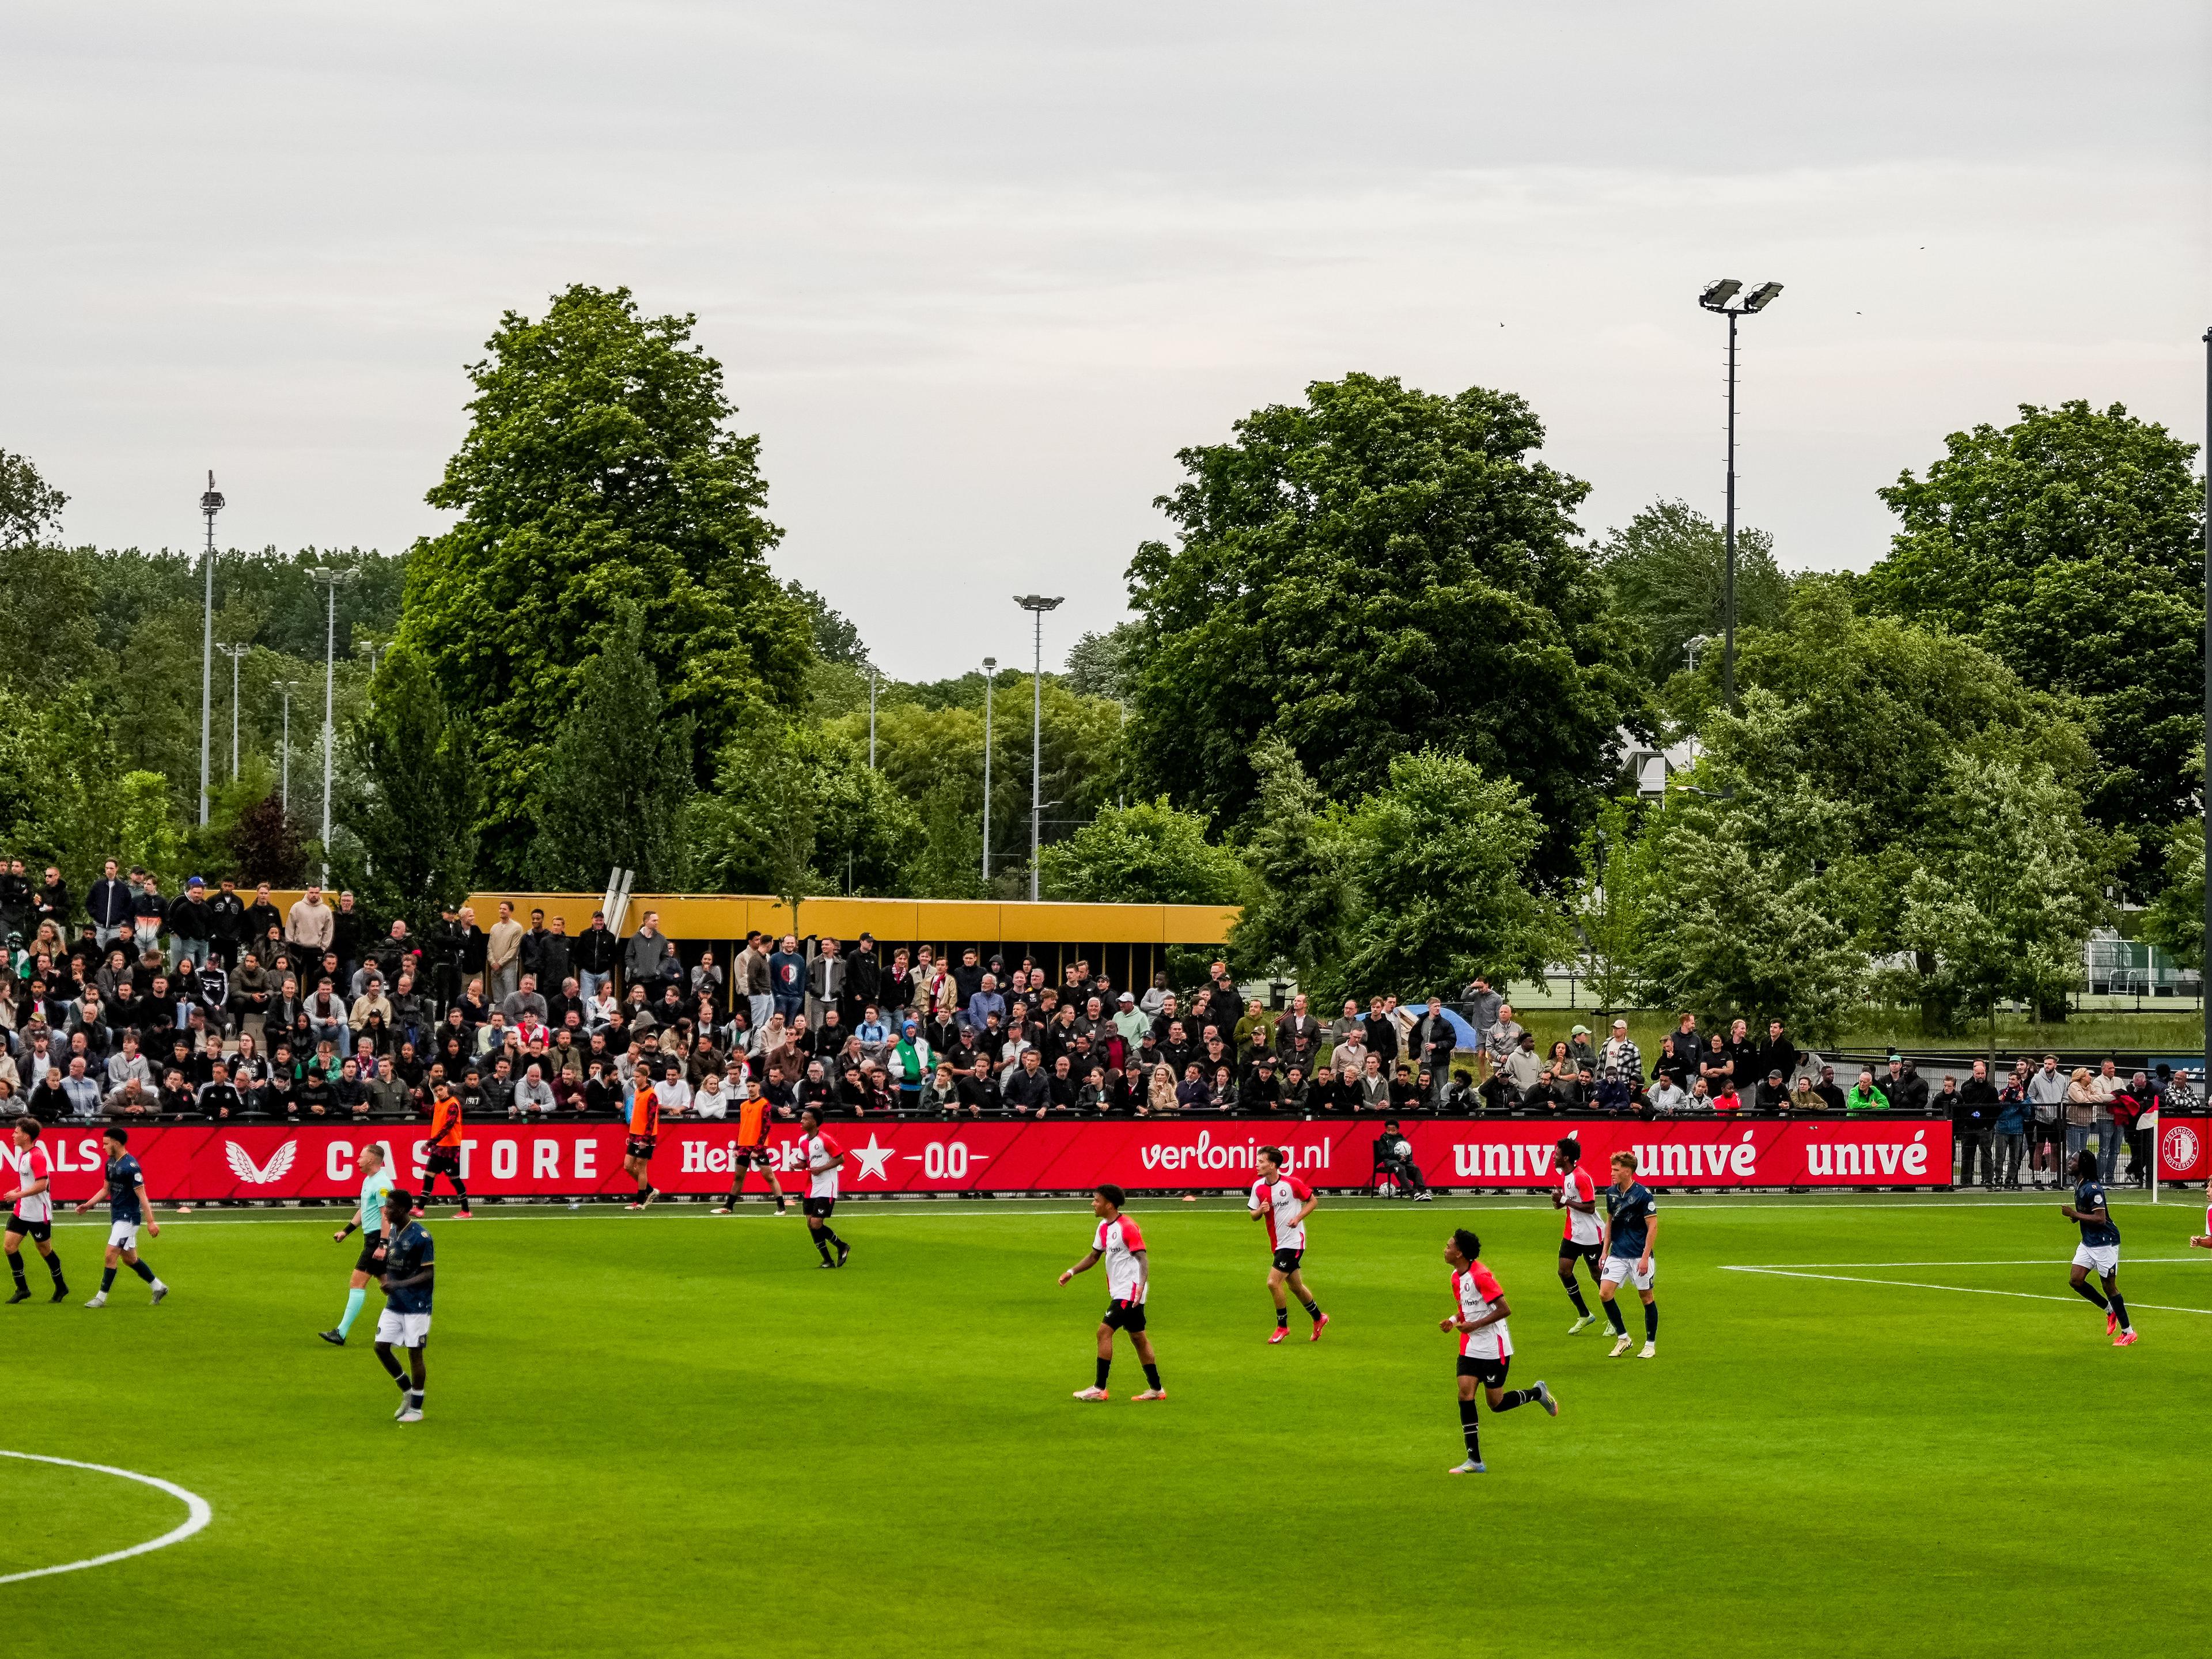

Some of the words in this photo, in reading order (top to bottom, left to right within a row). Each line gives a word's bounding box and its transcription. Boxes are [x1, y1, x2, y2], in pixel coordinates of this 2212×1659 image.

[681, 1140, 844, 1172] Heiek
[1141, 1130, 1330, 1176] verlonig.nl
[1453, 1130, 1578, 1176] univ
[1632, 1130, 1756, 1176] univé
[1806, 1130, 1927, 1176] univé
[2165, 1128, 2196, 1143] FEYENOORD
[2165, 1154, 2196, 1169] ROTTERDAM
